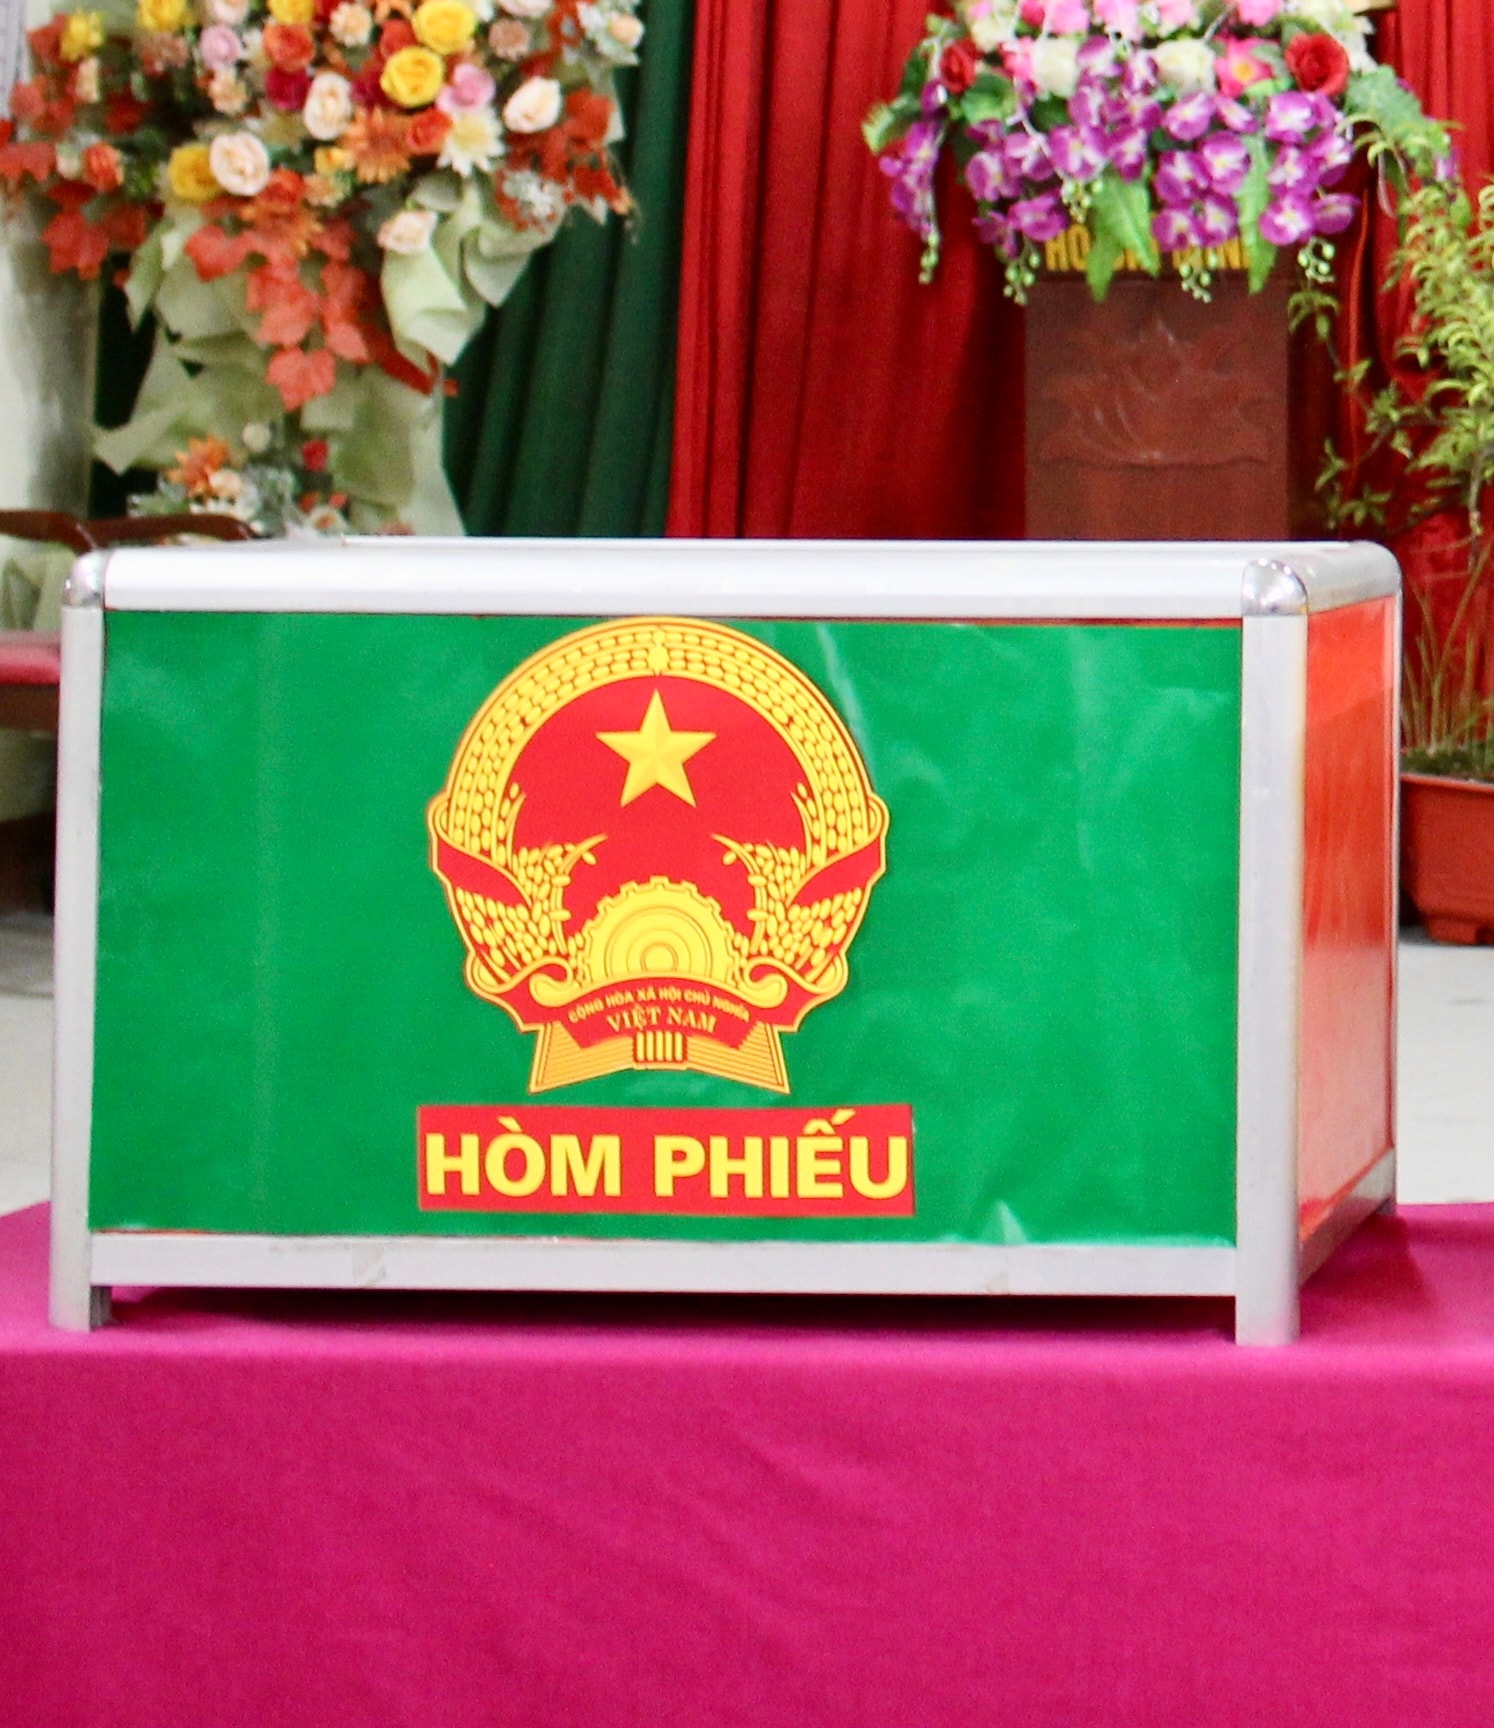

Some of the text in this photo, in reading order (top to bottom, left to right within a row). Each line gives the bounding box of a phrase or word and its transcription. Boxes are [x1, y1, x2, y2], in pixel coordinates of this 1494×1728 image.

[606, 1003, 716, 1033] VIỆT NAM
[426, 1109, 908, 1199] HÒM PHIẾU
